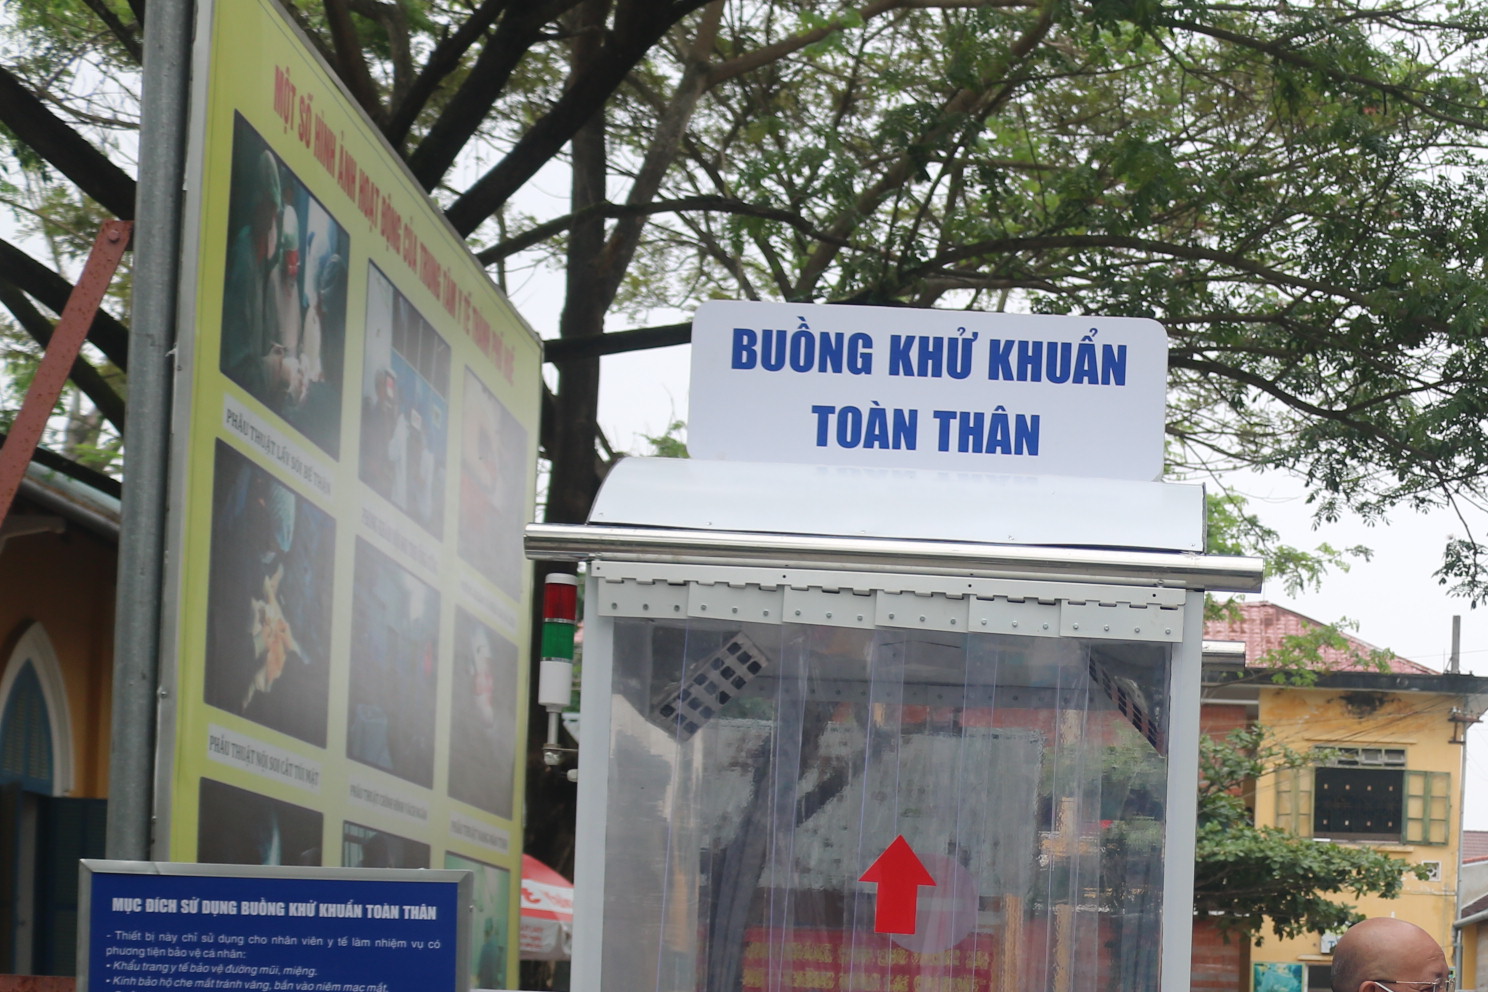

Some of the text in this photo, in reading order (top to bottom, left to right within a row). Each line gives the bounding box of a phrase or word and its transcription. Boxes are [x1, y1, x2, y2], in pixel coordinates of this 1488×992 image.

[731, 316, 1128, 387] BUỒNG KHỬ KHUẨN
[811, 401, 1041, 456] TOÀN THÂN
[112, 896, 437, 920] MỤC ĐÍCH SỬ DỤNG BUỒNG KHỬ KHUẨN TOÀN THÂN
[115, 930, 441, 950] Thiết bị này chỉ sử dụng cho nhân viên y tế làm nhiệm vụ có
[105, 947, 246, 959] phương tiện bảo vệ cá nhân:
[113, 959, 317, 978] Khẩu trang y tế bảo vệ đường mũi, miệng.
